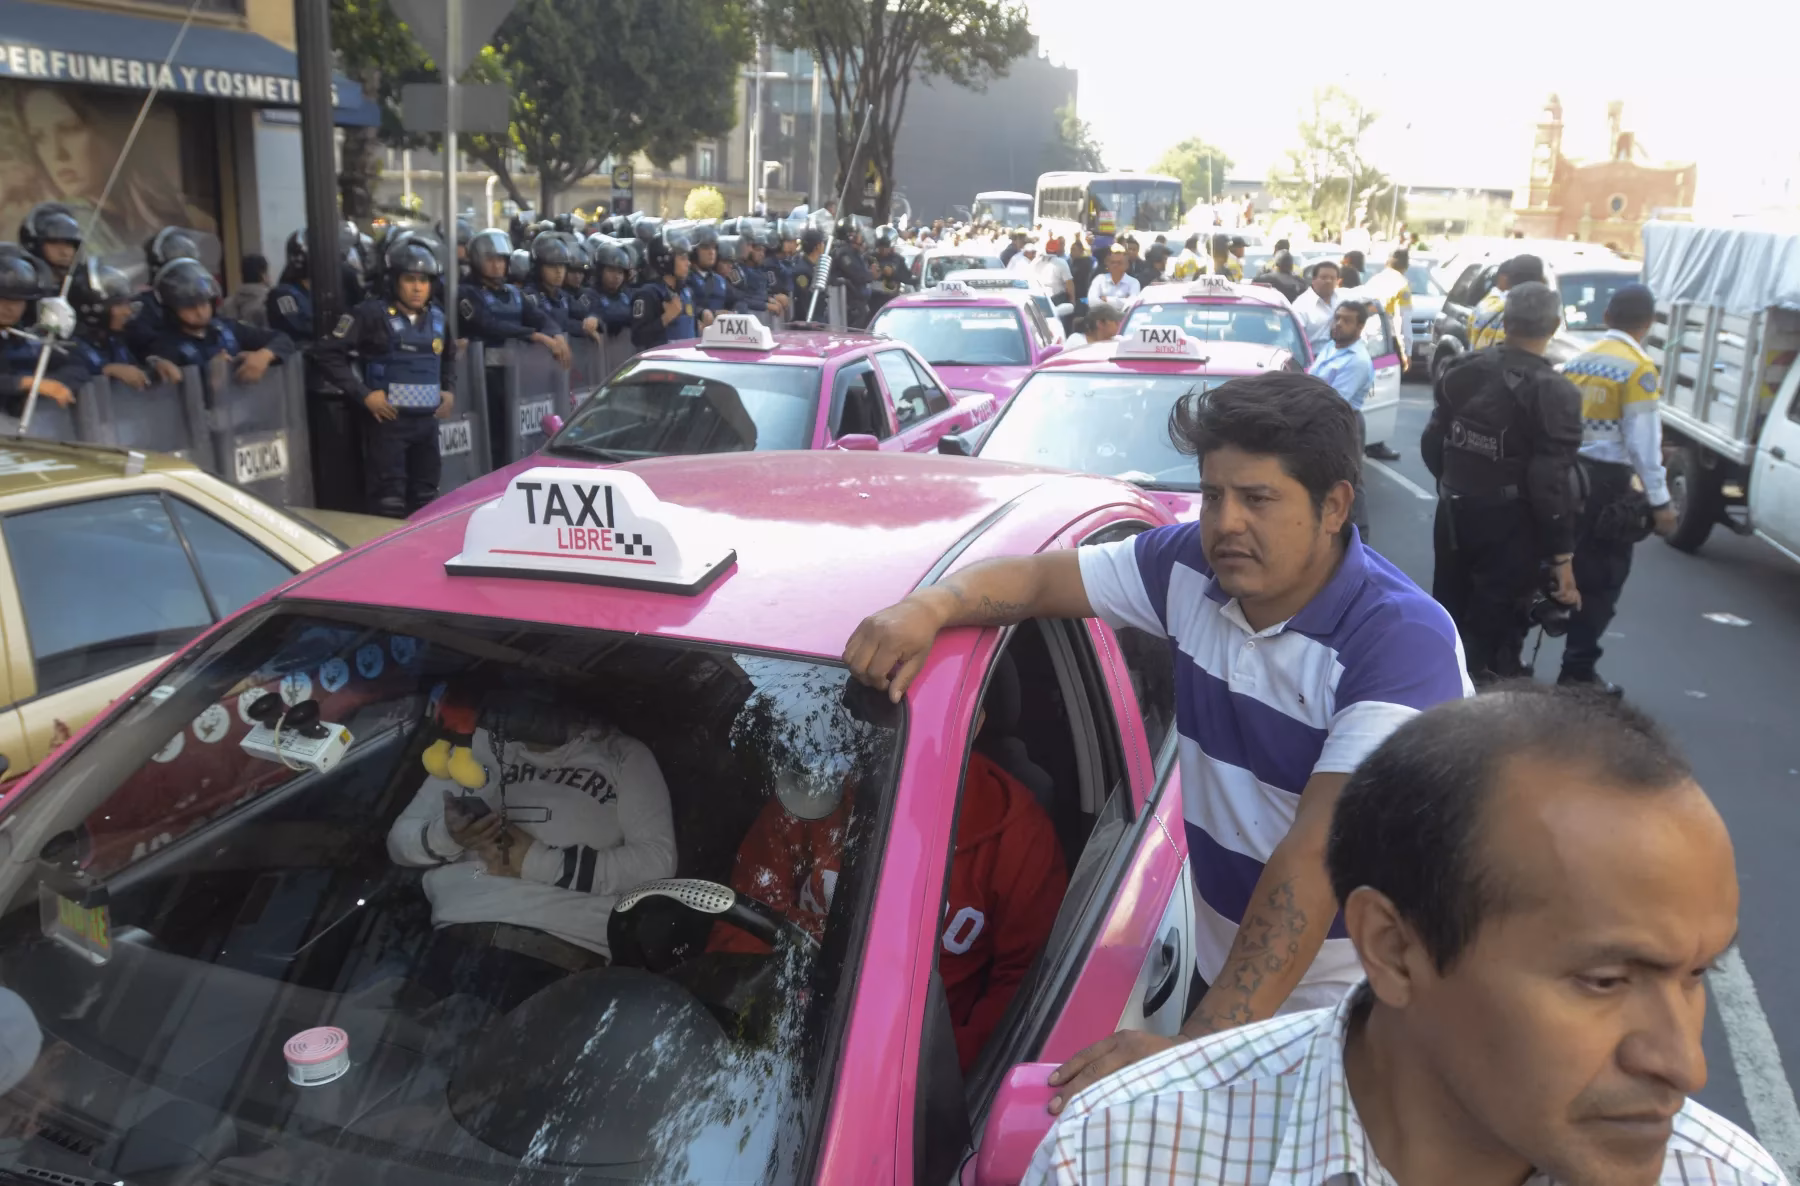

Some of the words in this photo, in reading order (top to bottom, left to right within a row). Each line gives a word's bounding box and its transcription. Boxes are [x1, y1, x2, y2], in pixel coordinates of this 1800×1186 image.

[180, 66, 198, 92] Y
[203, 69, 339, 106] COSMETIS
[940, 283, 962, 291] TAXI
[1202, 278, 1224, 287] TAXI
[717, 318, 748, 335] TAXI
[1140, 328, 1177, 343] TAXI
[238, 444, 282, 475] POLICIA
[515, 481, 615, 529] TAXI
[557, 527, 613, 551] LIBRE
